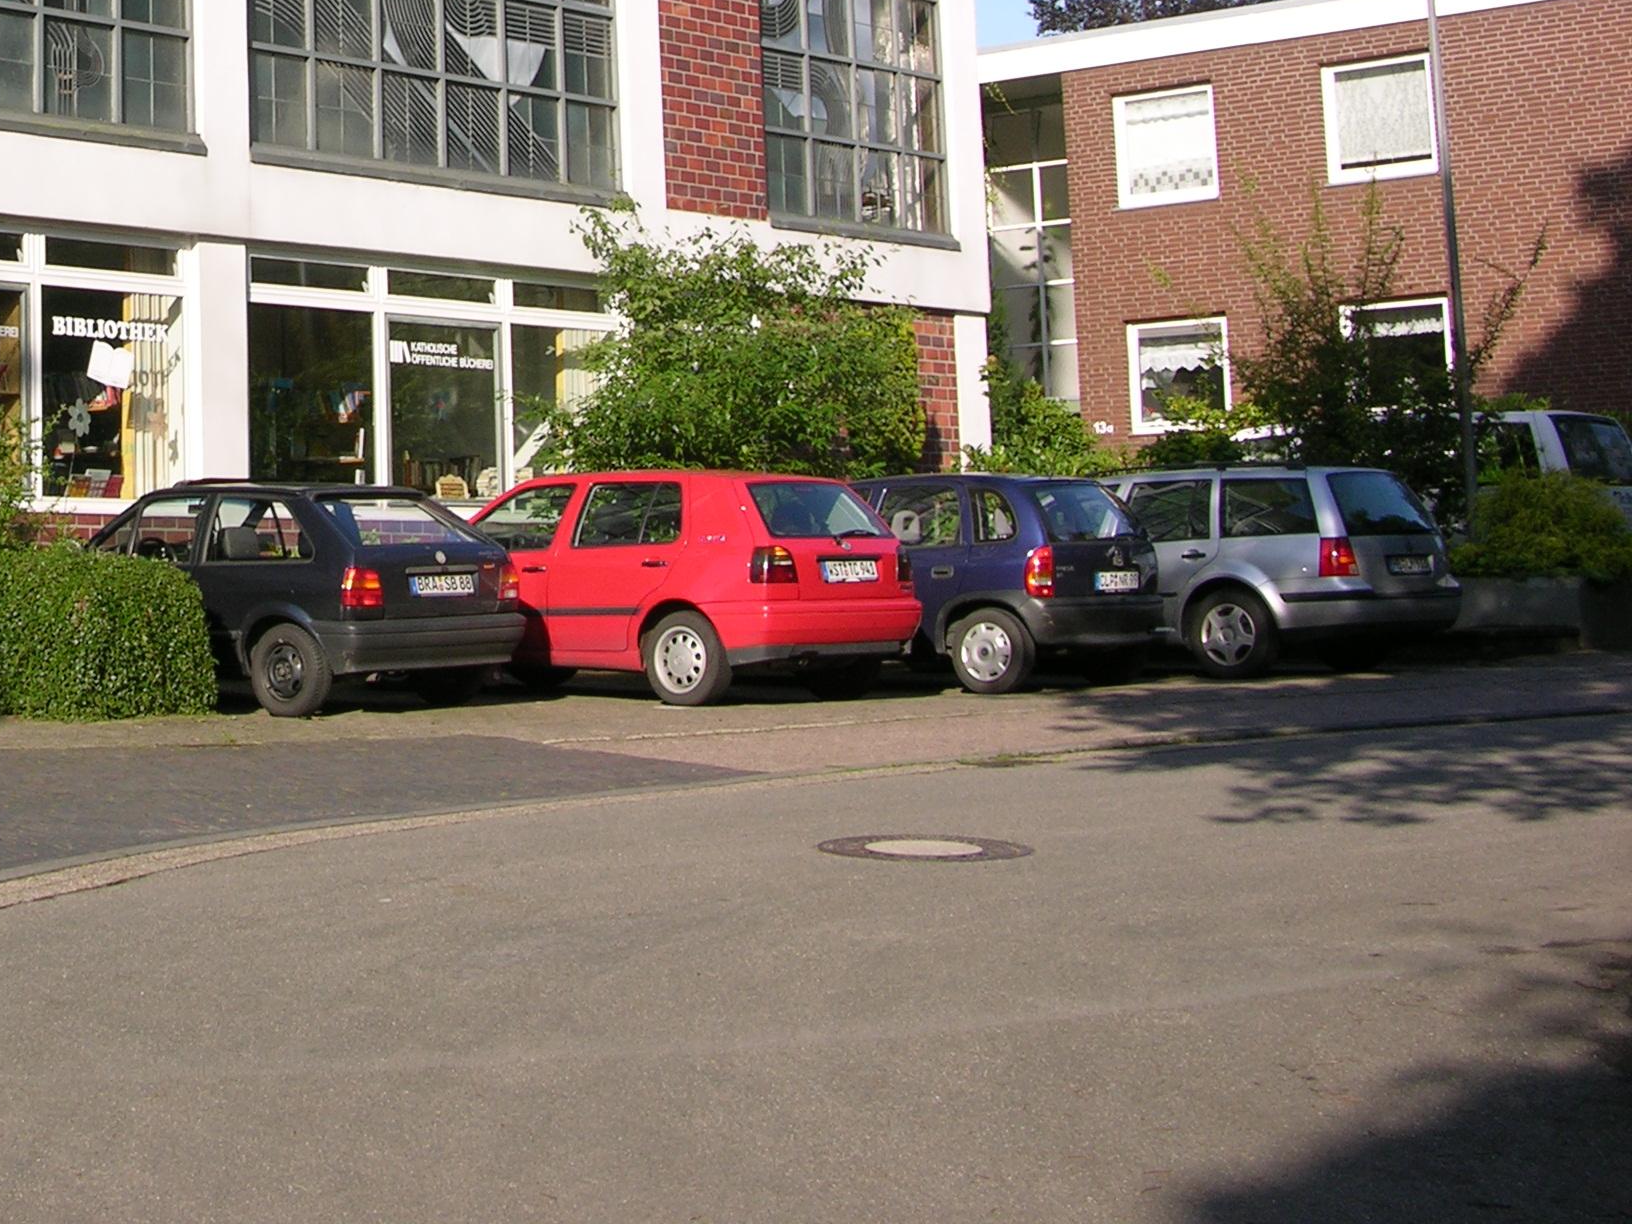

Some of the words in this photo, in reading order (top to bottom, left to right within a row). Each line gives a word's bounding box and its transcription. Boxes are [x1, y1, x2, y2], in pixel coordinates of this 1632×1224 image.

[52, 315, 169, 344] BIBLIOTHEK
[410, 341, 458, 355] KATHOLISCHE
[411, 353, 458, 368] ÖFFENTLICHE
[459, 355, 494, 370] BÜCHEREI
[1093, 420, 1114, 435] 13a
[417, 577, 438, 592] BRA
